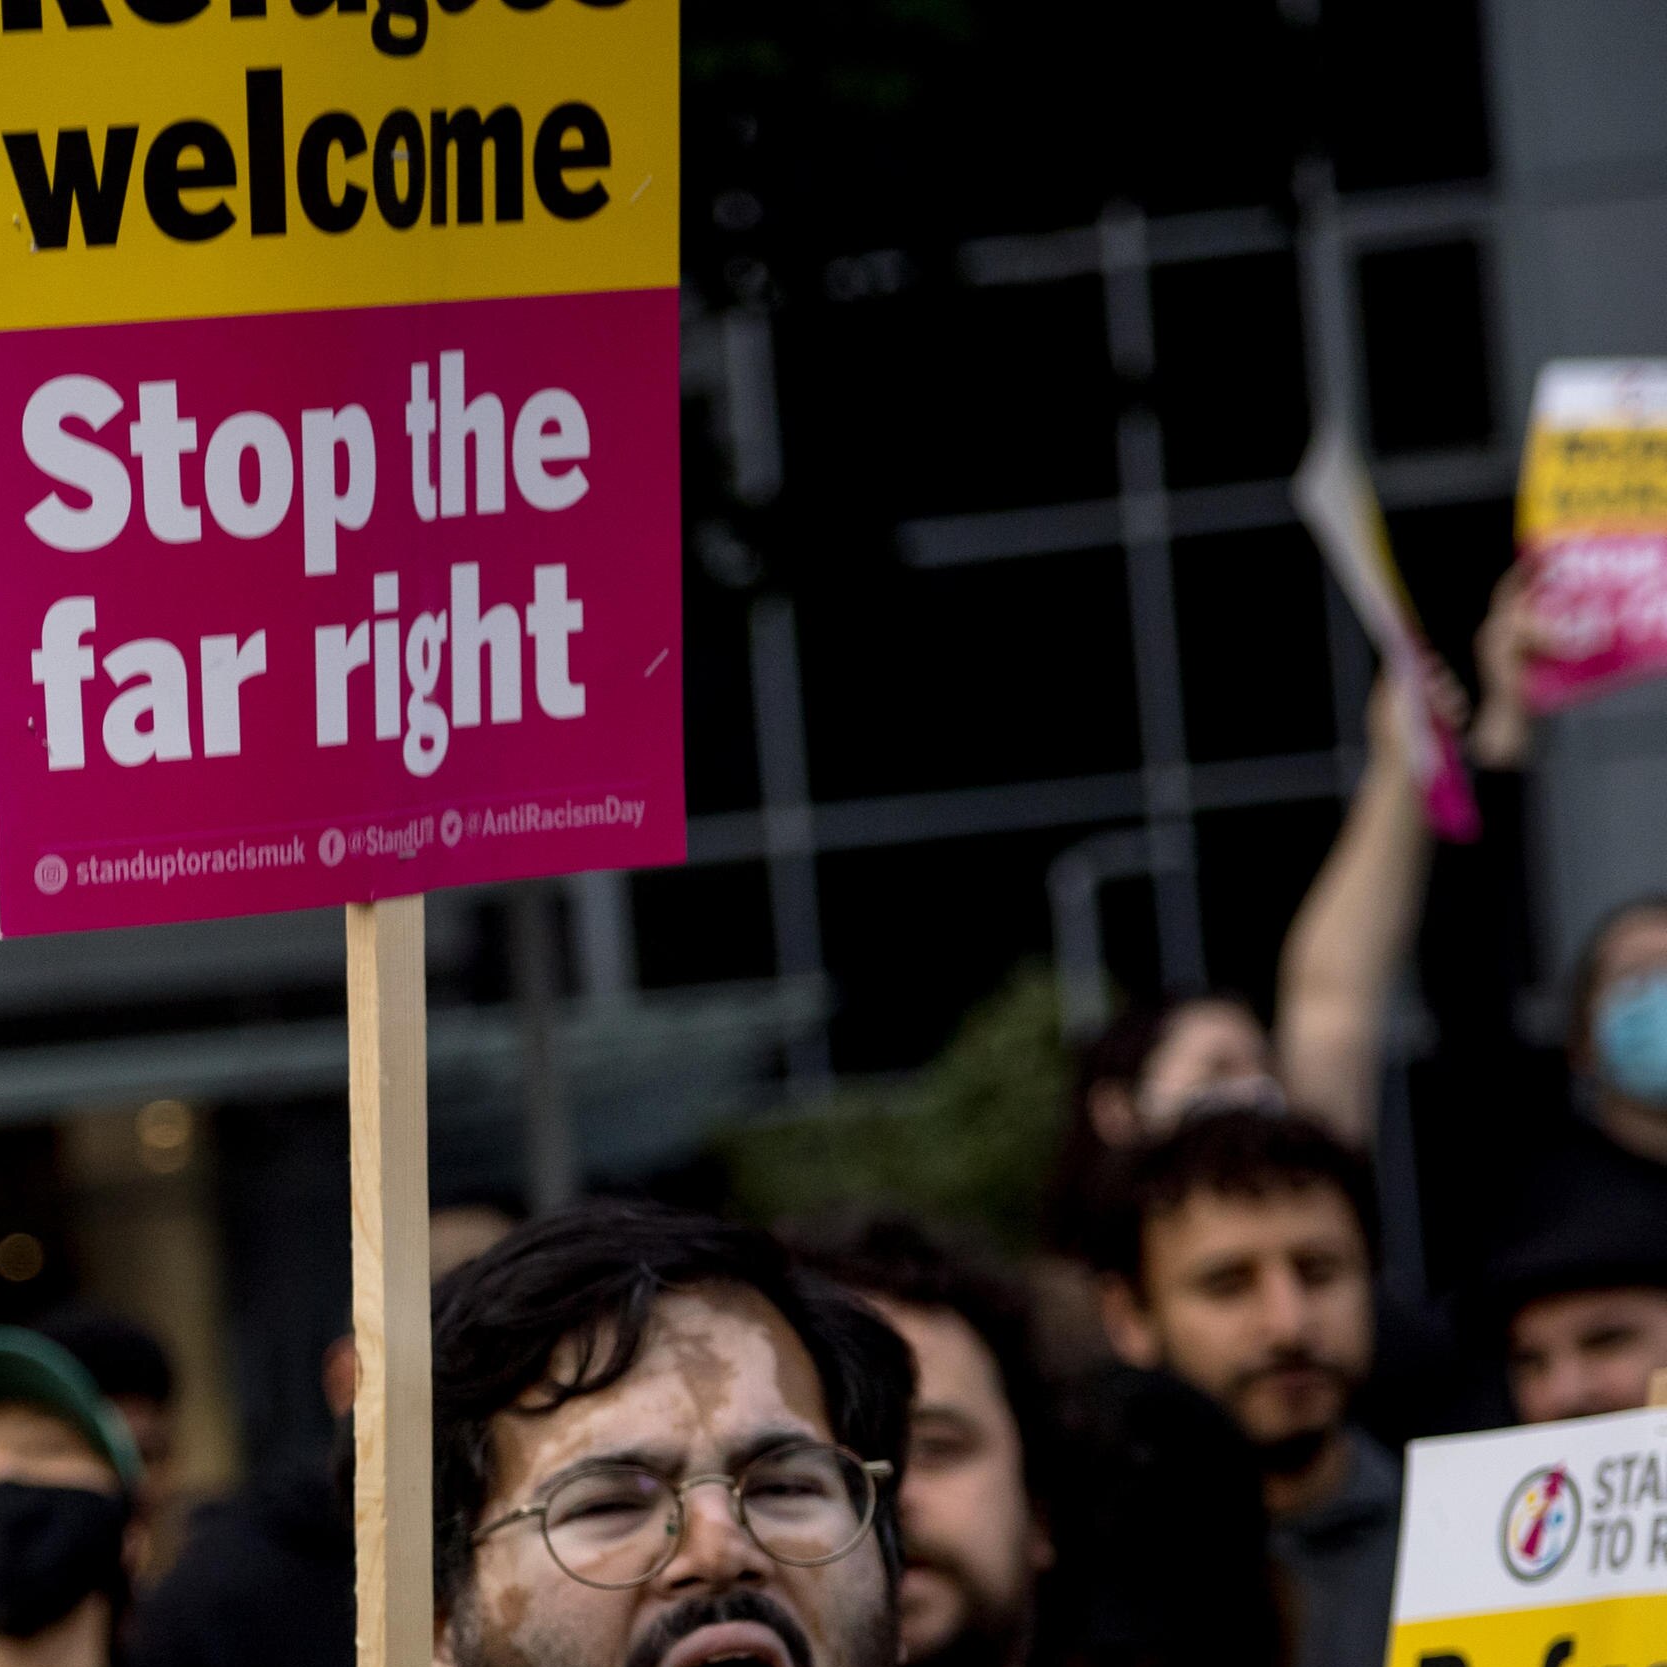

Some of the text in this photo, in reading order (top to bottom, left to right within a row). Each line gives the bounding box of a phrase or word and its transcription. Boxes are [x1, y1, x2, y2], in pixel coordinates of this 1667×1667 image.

[1, 67, 614, 252] welcome
[20, 349, 592, 577] Stop the
[30, 562, 587, 779] far right
[75, 834, 307, 887] standuptoracismuk
[1593, 1450, 1667, 1510] STA
[1589, 1515, 1635, 1575] TO
